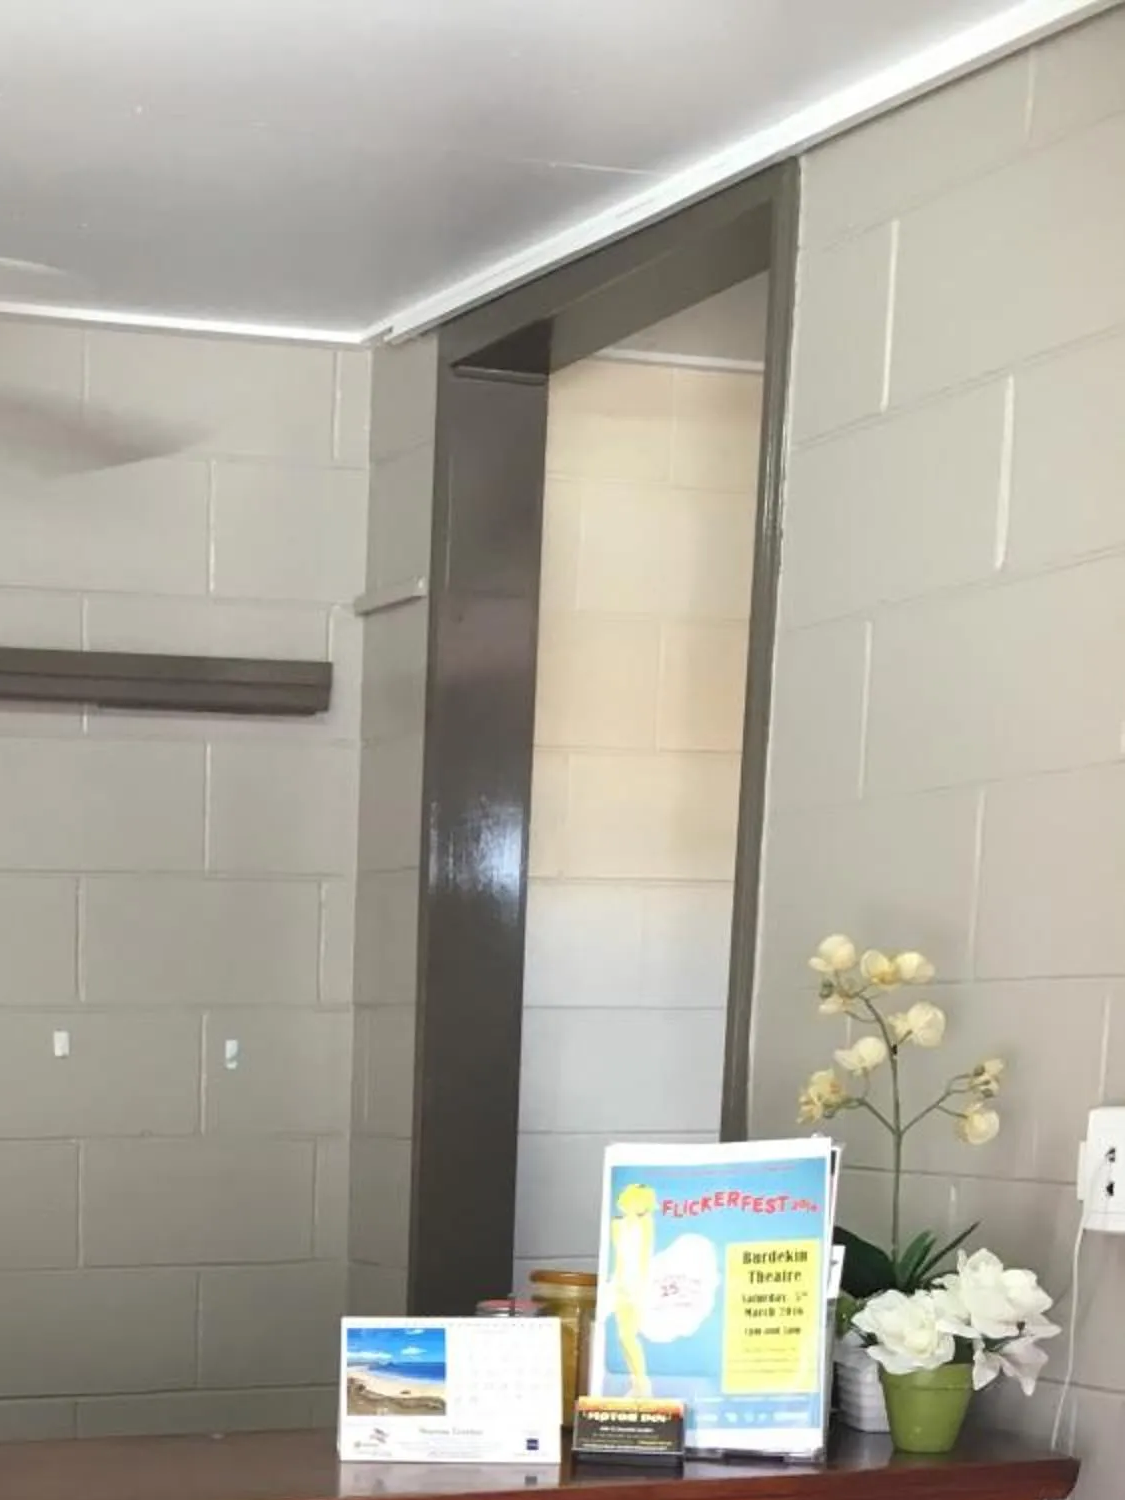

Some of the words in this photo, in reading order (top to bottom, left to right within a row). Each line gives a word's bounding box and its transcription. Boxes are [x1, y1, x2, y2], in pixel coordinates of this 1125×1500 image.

[662, 1191, 790, 1217] FLICKERFEST
[742, 1250, 808, 1264] Burdekin
[748, 1270, 802, 1284] Theatre
[744, 1307, 776, 1318] March
[779, 1306, 804, 1316] 2016
